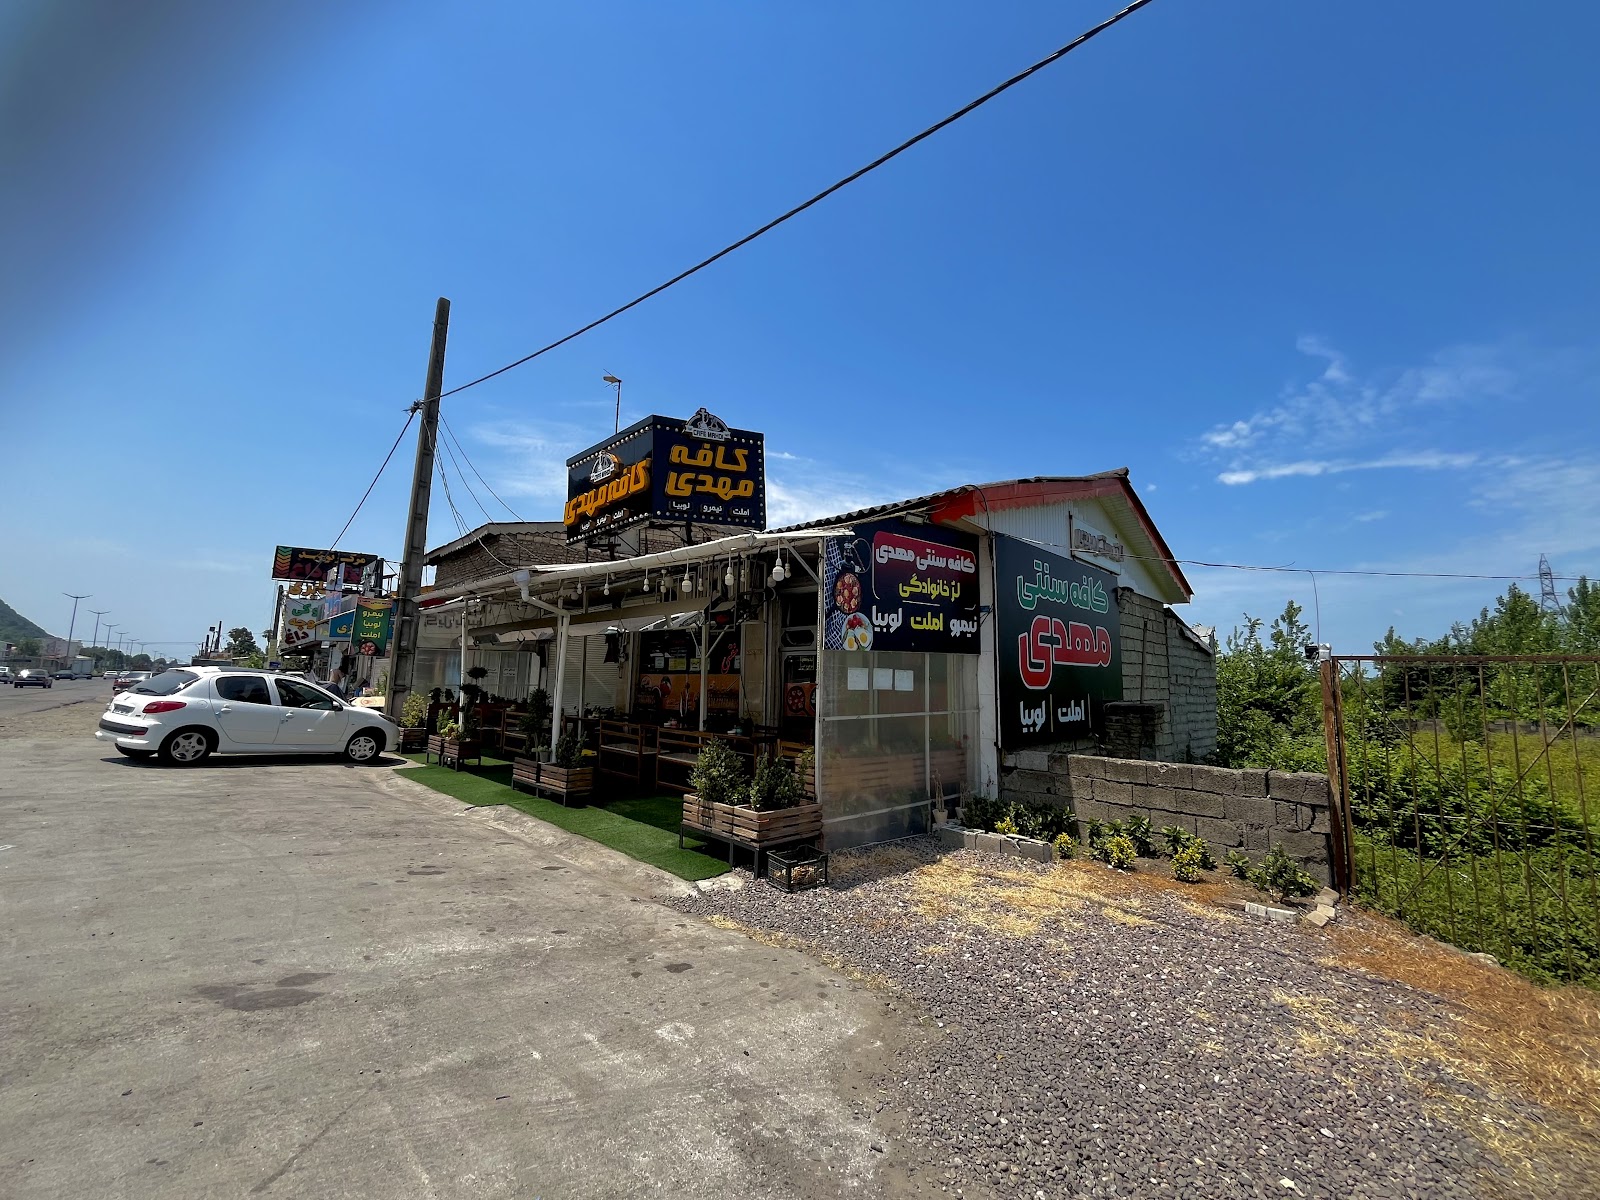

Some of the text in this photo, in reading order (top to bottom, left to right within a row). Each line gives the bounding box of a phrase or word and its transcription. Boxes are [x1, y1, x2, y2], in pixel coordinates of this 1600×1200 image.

[669, 443, 749, 472] کافه
[563, 458, 651, 527] کافه مهدی
[665, 470, 755, 500] مهدی
[672, 500, 750, 516] املت نیمرو لوبیا
[875, 544, 976, 574] کافه سنتی مهدی
[899, 573, 950, 600] خانوادگی
[1017, 559, 1109, 614] کافه سنتی
[362, 610, 384, 619] نیمرو
[363, 619, 381, 629] لوبیا
[872, 605, 978, 638] نیمرو املت لوبیا
[285, 628, 309, 644] داغ
[360, 631, 381, 639] املت
[1018, 615, 1112, 690] مهدی
[1019, 699, 1085, 733] املت لوبیا
